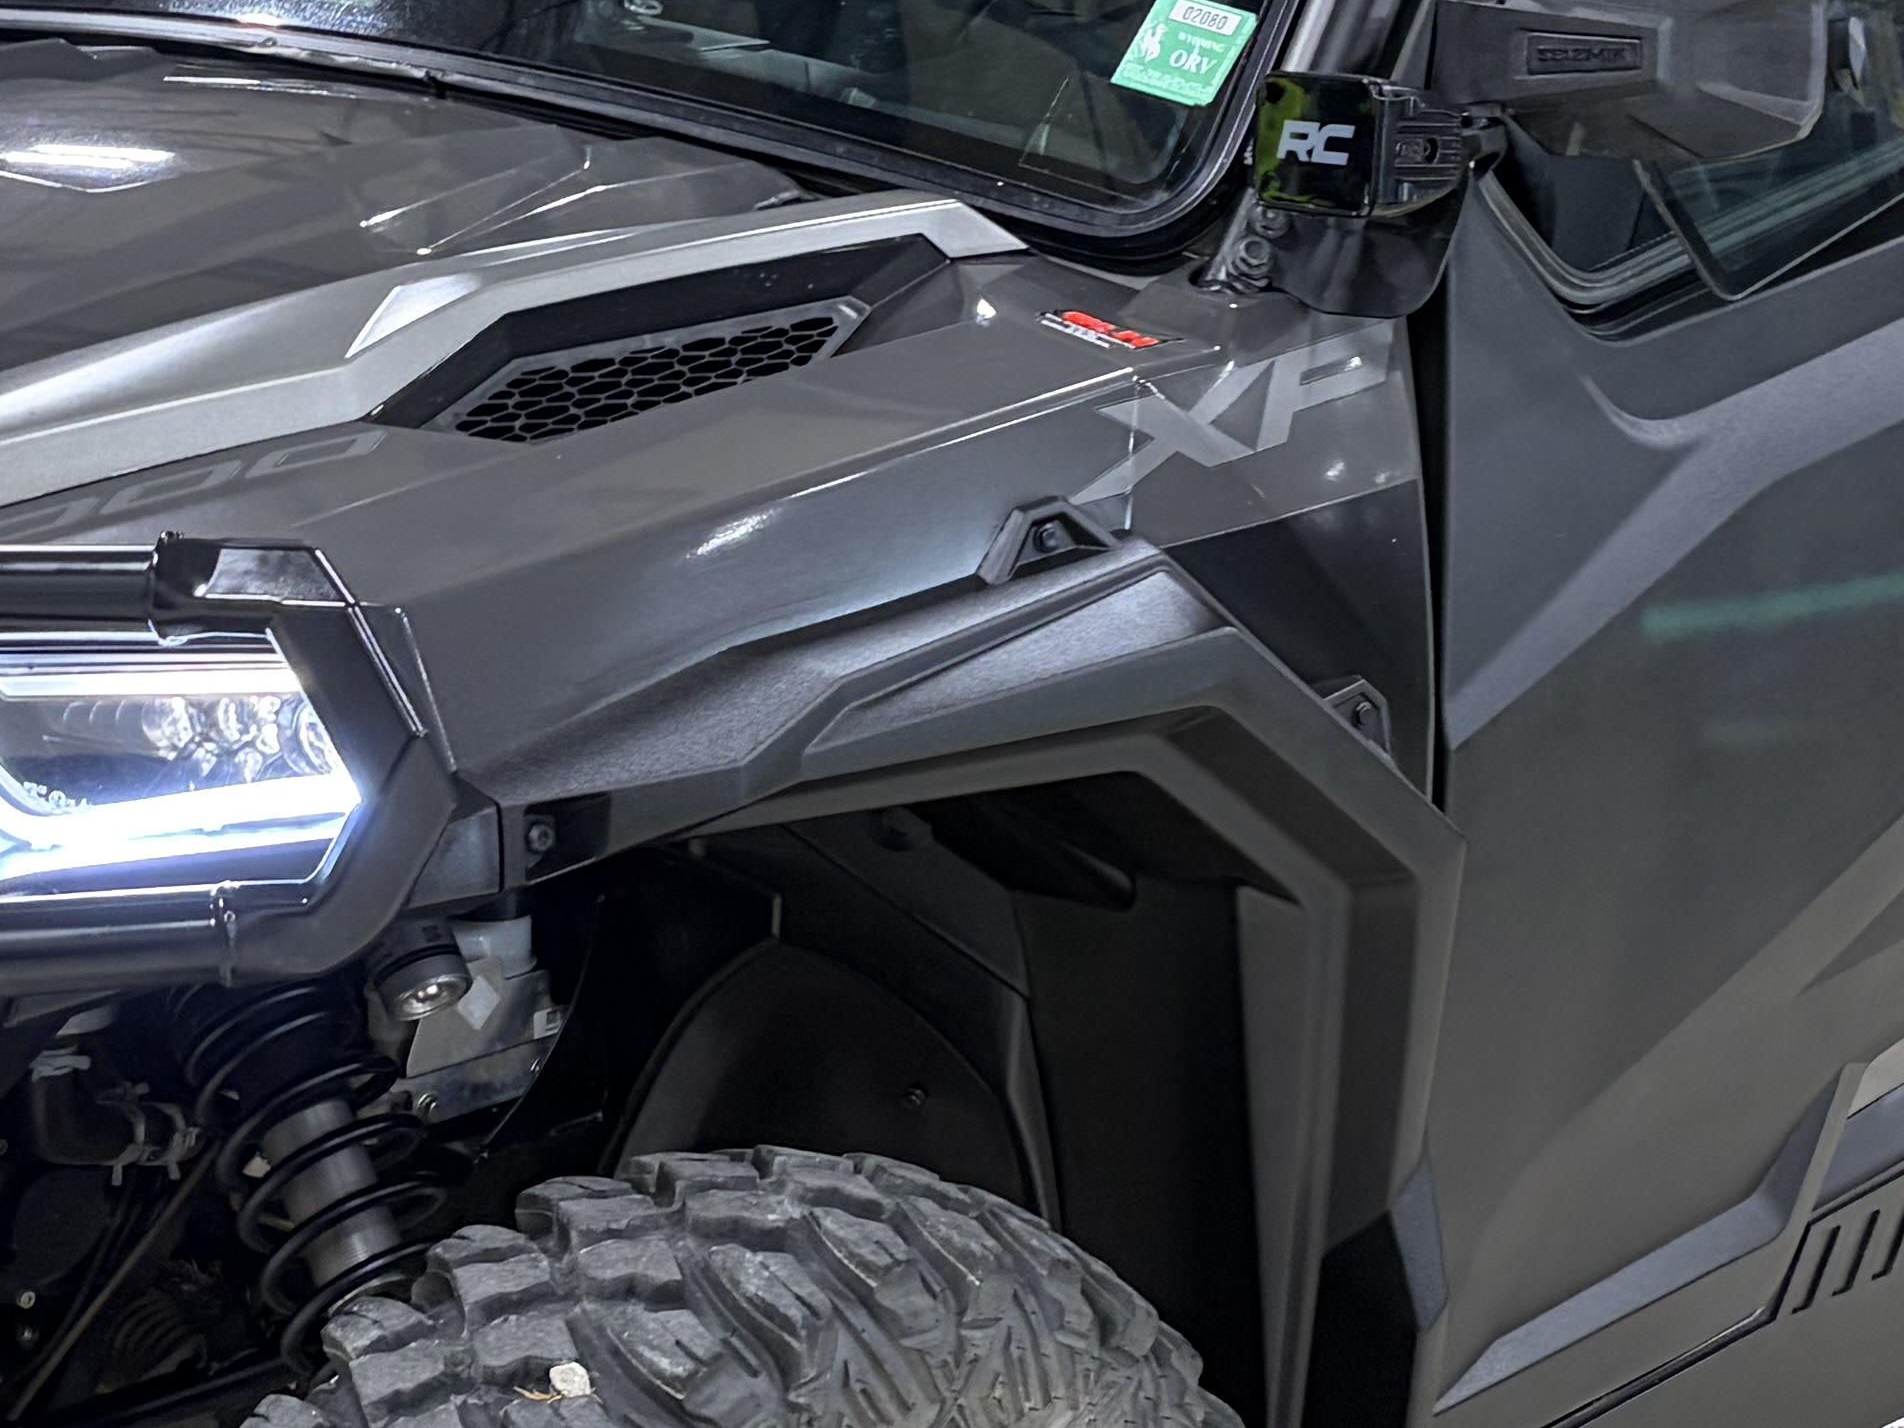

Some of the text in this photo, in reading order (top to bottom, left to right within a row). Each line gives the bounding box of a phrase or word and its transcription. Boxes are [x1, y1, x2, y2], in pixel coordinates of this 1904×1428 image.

[1170, 49, 1217, 75] ORV
[1276, 119, 1356, 166] RC
[1068, 319, 1393, 505] XP
